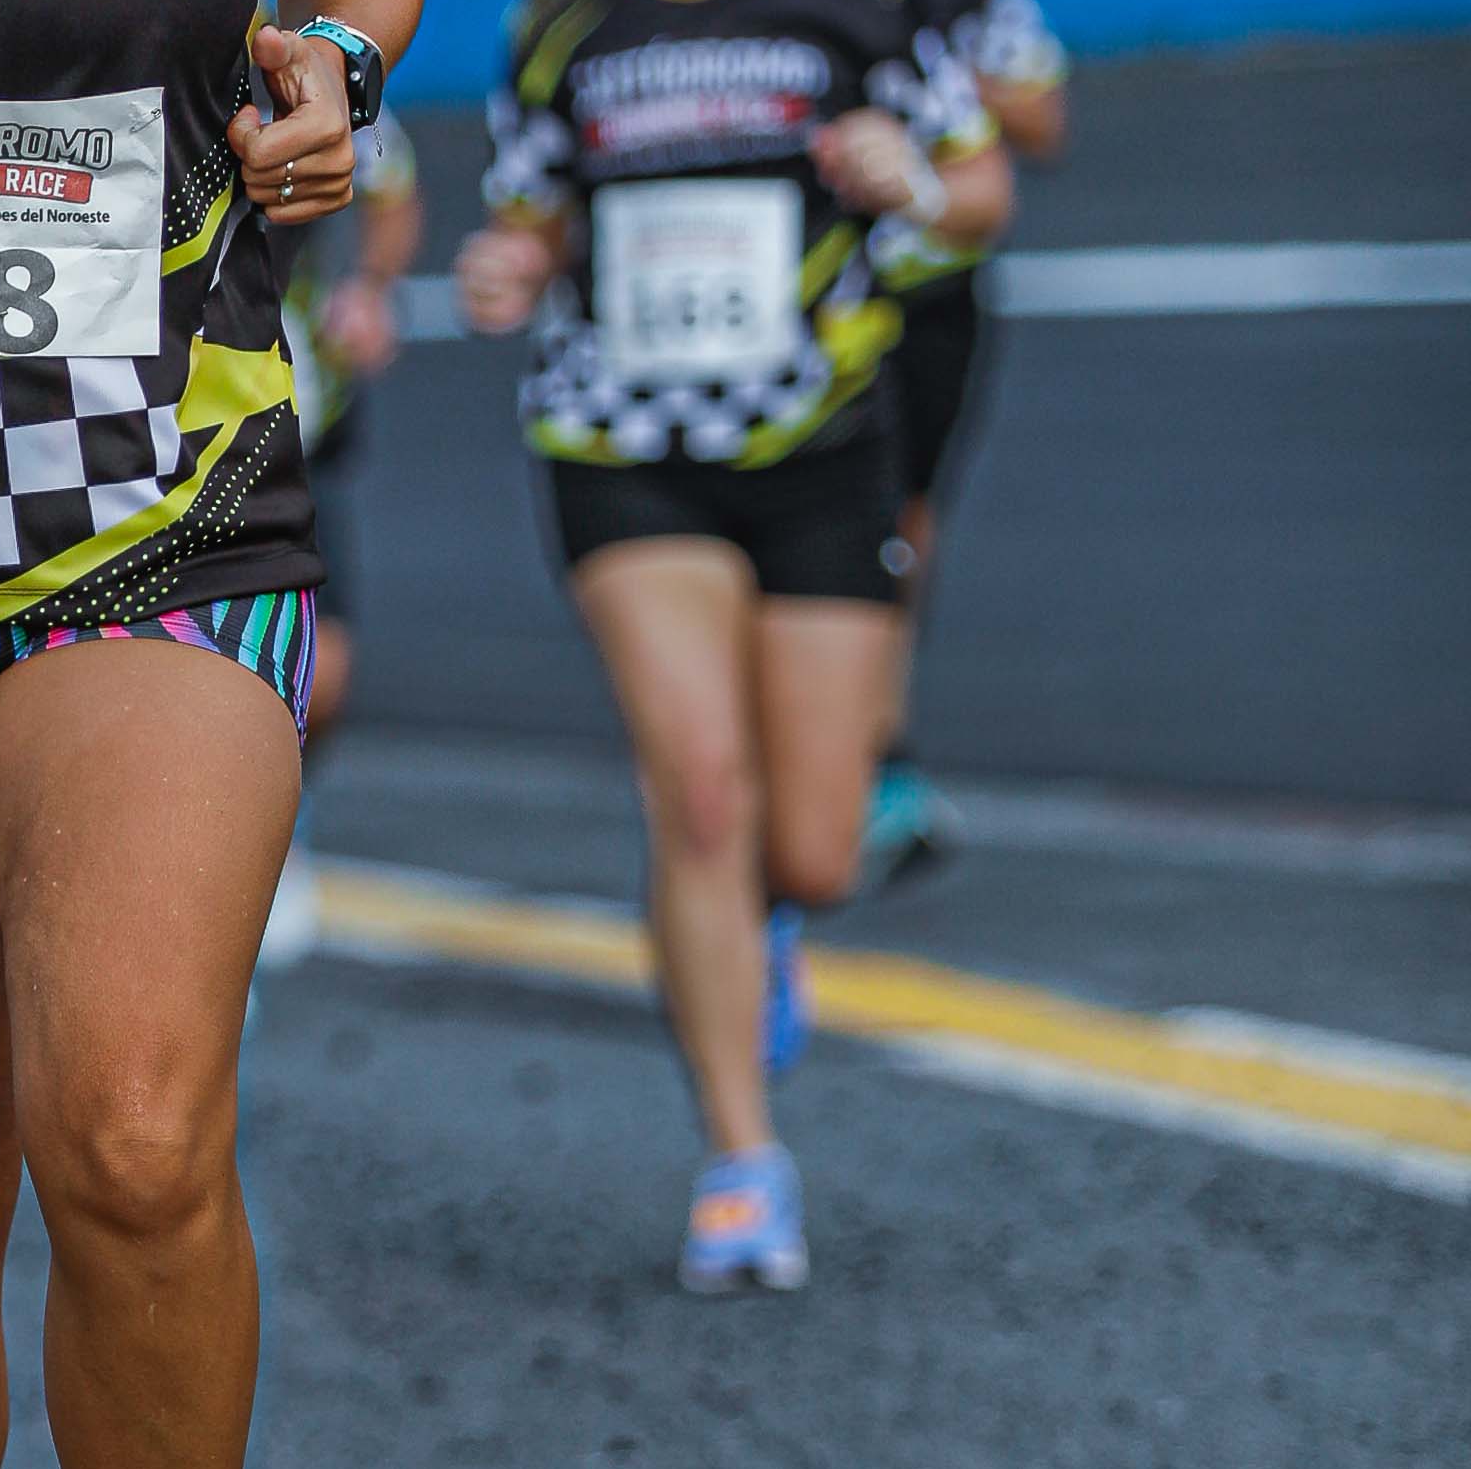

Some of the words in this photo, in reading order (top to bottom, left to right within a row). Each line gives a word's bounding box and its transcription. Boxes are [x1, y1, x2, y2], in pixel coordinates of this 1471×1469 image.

[5, 169, 67, 198] RACE
[21, 208, 43, 223] del
[46, 209, 111, 223] Noroeste
